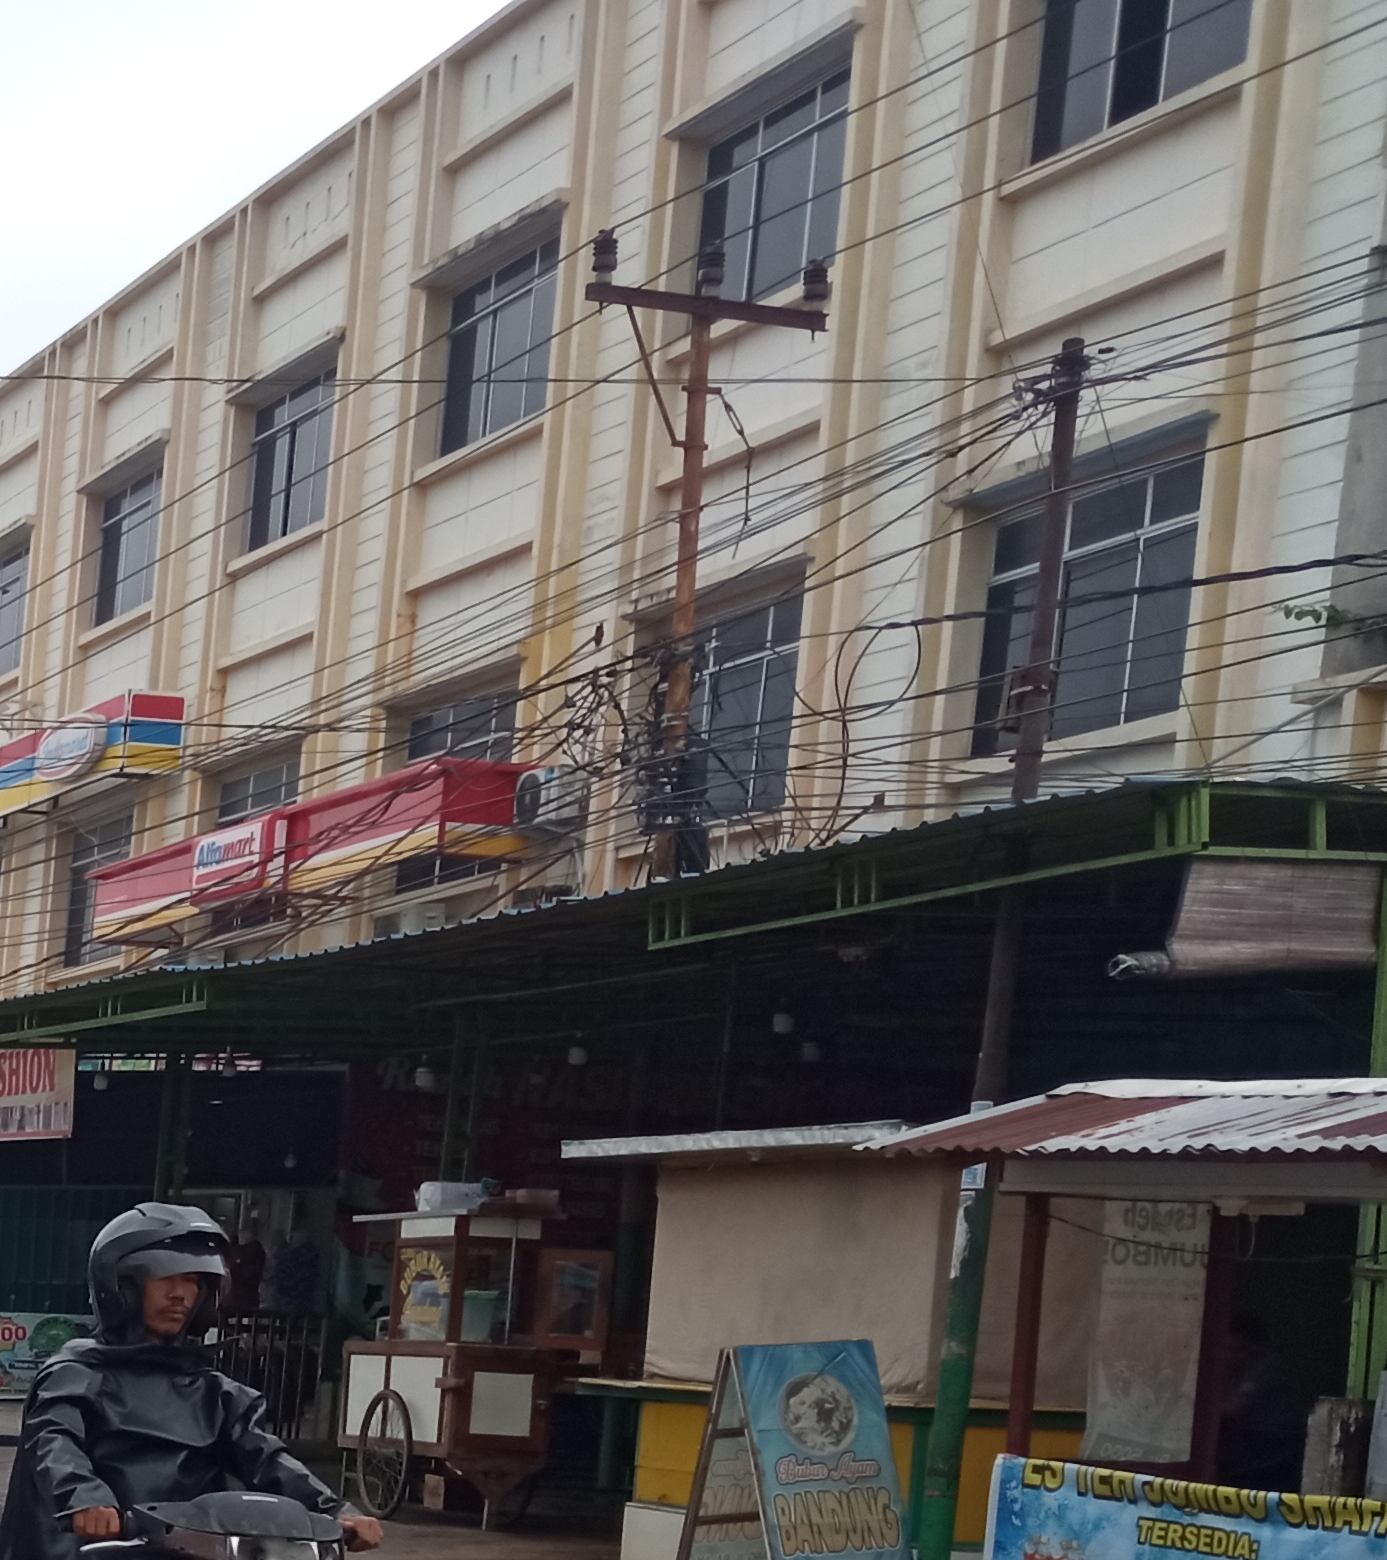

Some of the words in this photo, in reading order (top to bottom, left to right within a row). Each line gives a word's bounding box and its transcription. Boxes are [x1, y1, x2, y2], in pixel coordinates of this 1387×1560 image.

[196, 832, 255, 870] Alfamart
[777, 1454, 828, 1484] Bubur
[829, 1452, 880, 1484] Ayam
[773, 1487, 900, 1557] BANDUNG
